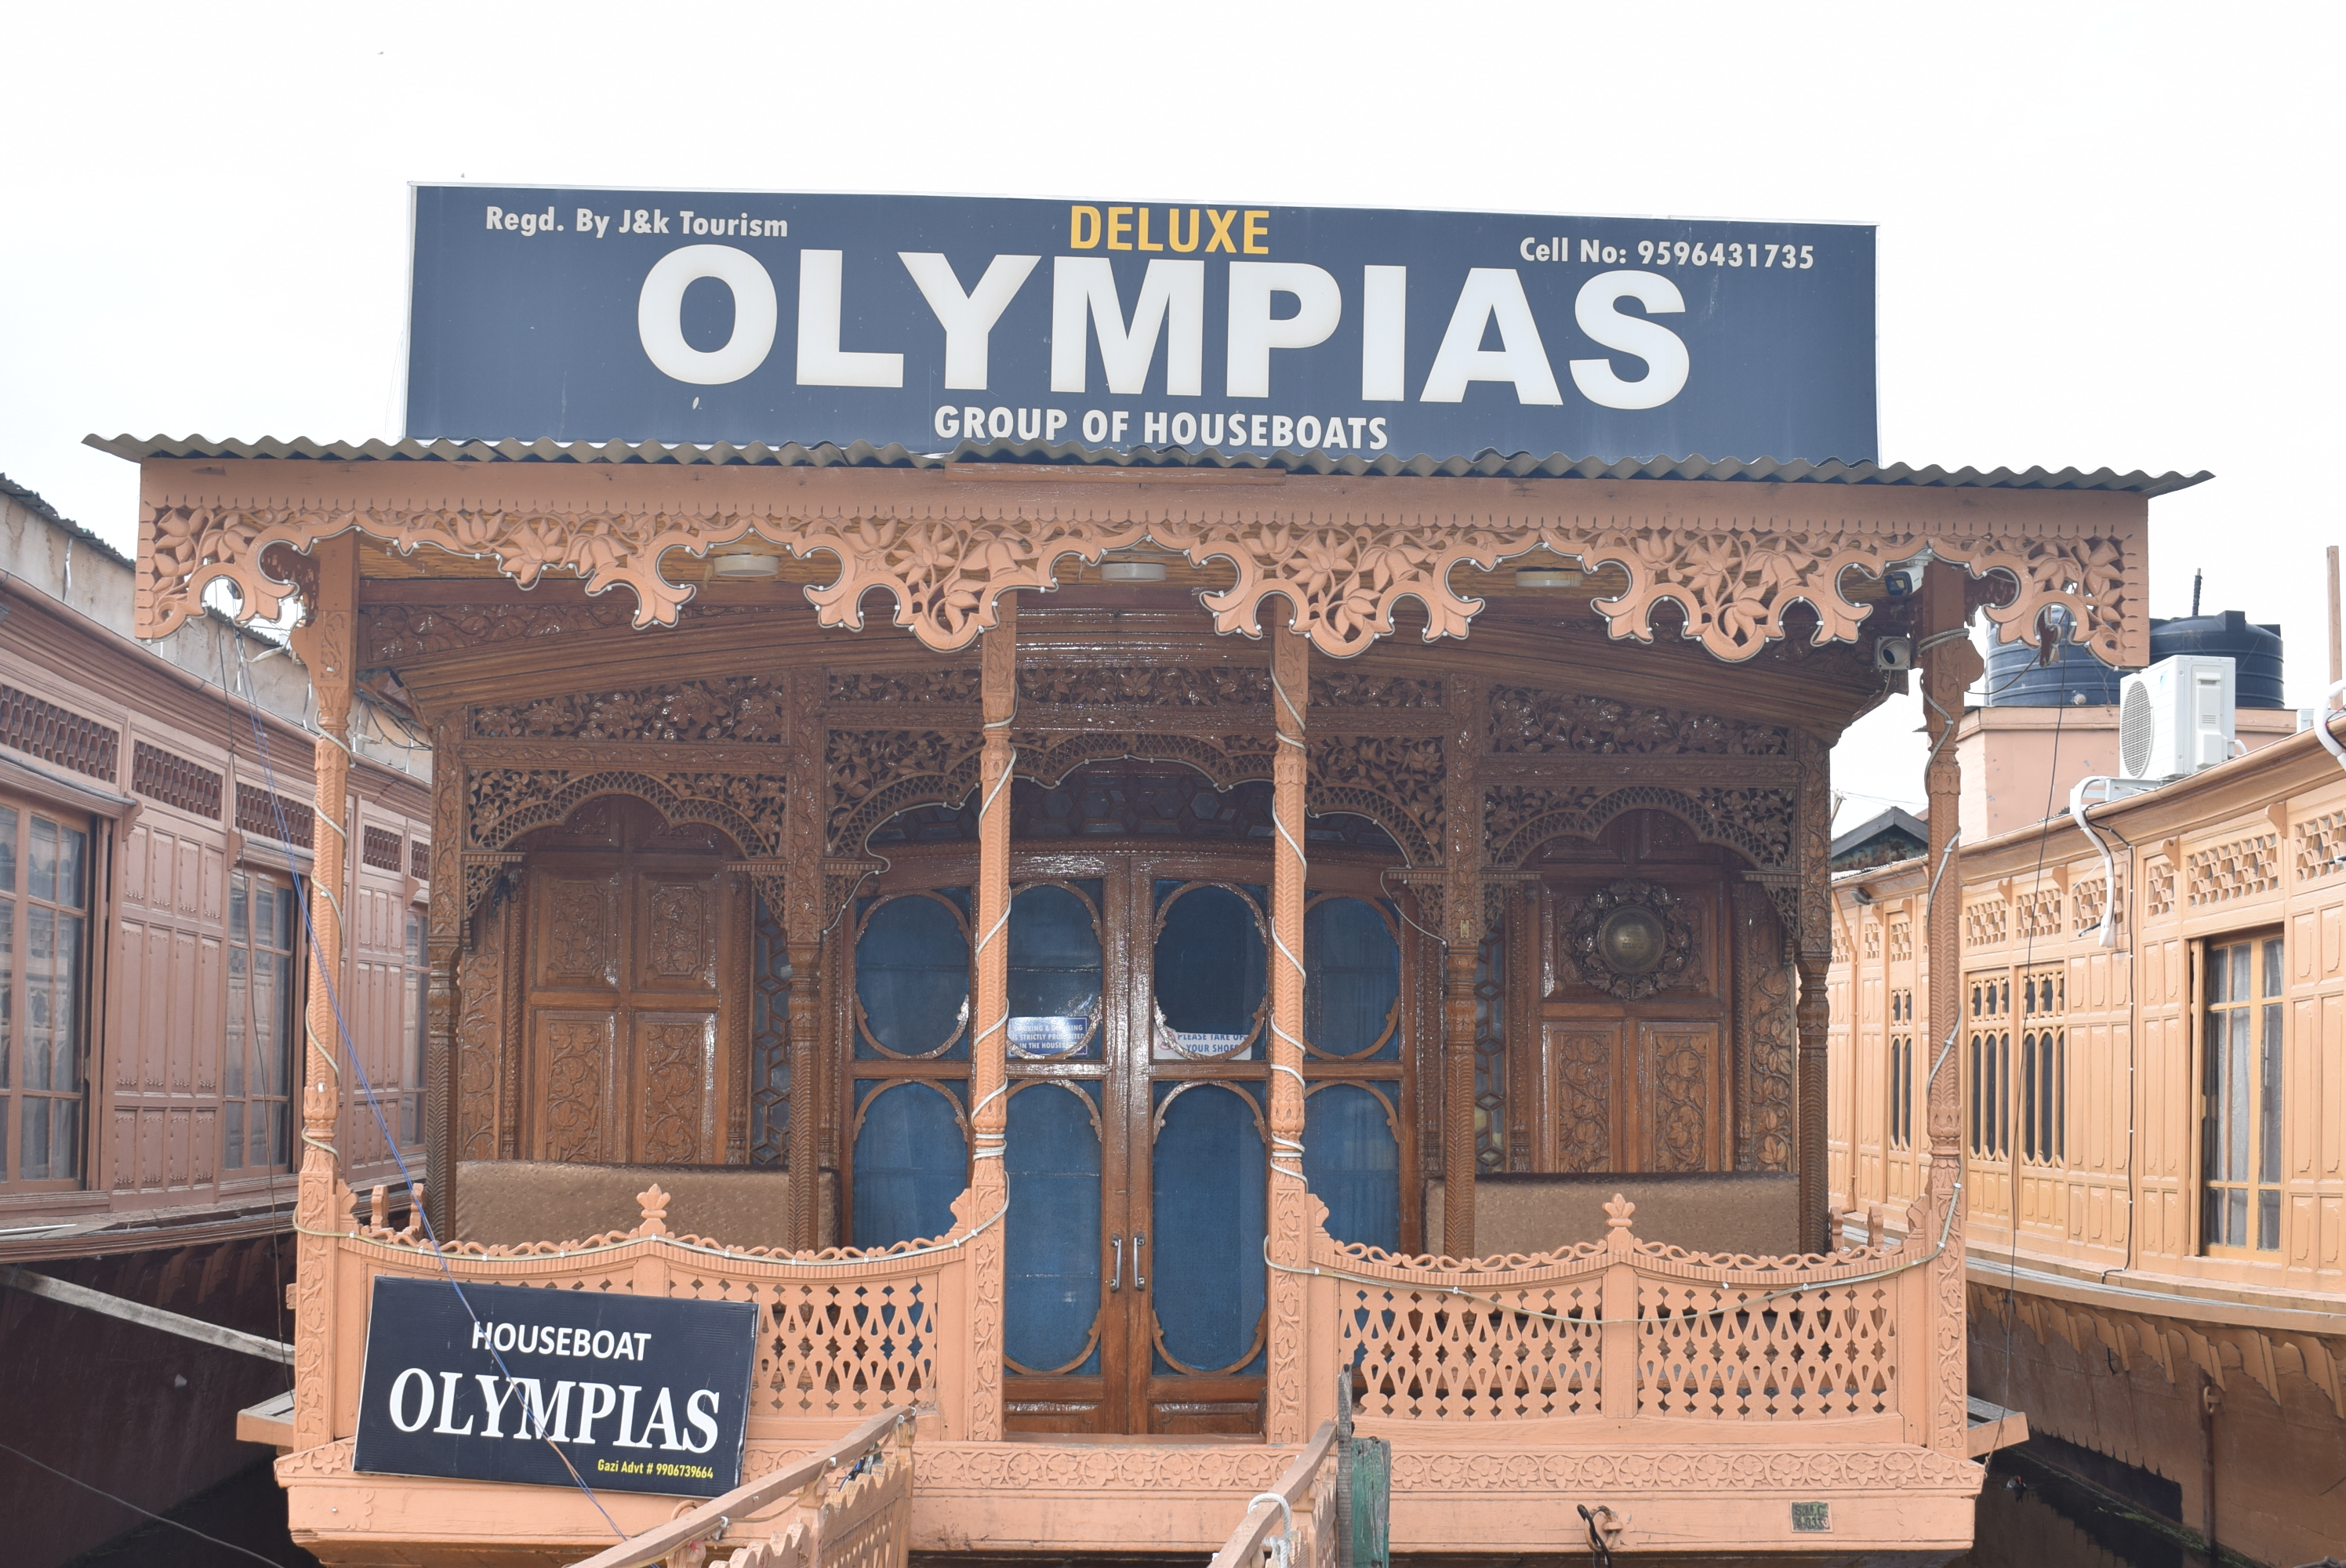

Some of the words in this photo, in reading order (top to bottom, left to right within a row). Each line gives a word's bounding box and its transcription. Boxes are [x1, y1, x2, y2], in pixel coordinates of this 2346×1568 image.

[486, 205, 565, 237] Regd.
[576, 208, 610, 238] By
[619, 209, 670, 234] J&k
[679, 210, 788, 238] Tourism
[1070, 205, 1269, 255] DELUXE
[1520, 237, 1568, 262] Cell
[1580, 238, 1627, 264] No:
[1637, 240, 1814, 270] 9596431735
[637, 244, 1690, 410] OLYMPIAS
[934, 405, 1068, 441] GROUP
[1082, 409, 1129, 443] OF
[1144, 412, 1388, 450] HOUSEBOATS
[1186, 1044, 1210, 1052] YOUR
[471, 1321, 652, 1361] HOUSEBOAT
[389, 1367, 720, 1454] OLYMPIAS
[597, 1459, 619, 1472] Gazi
[621, 1461, 644, 1474] Advt
[646, 1463, 654, 1475] #
[656, 1463, 714, 1479] 9906739664
